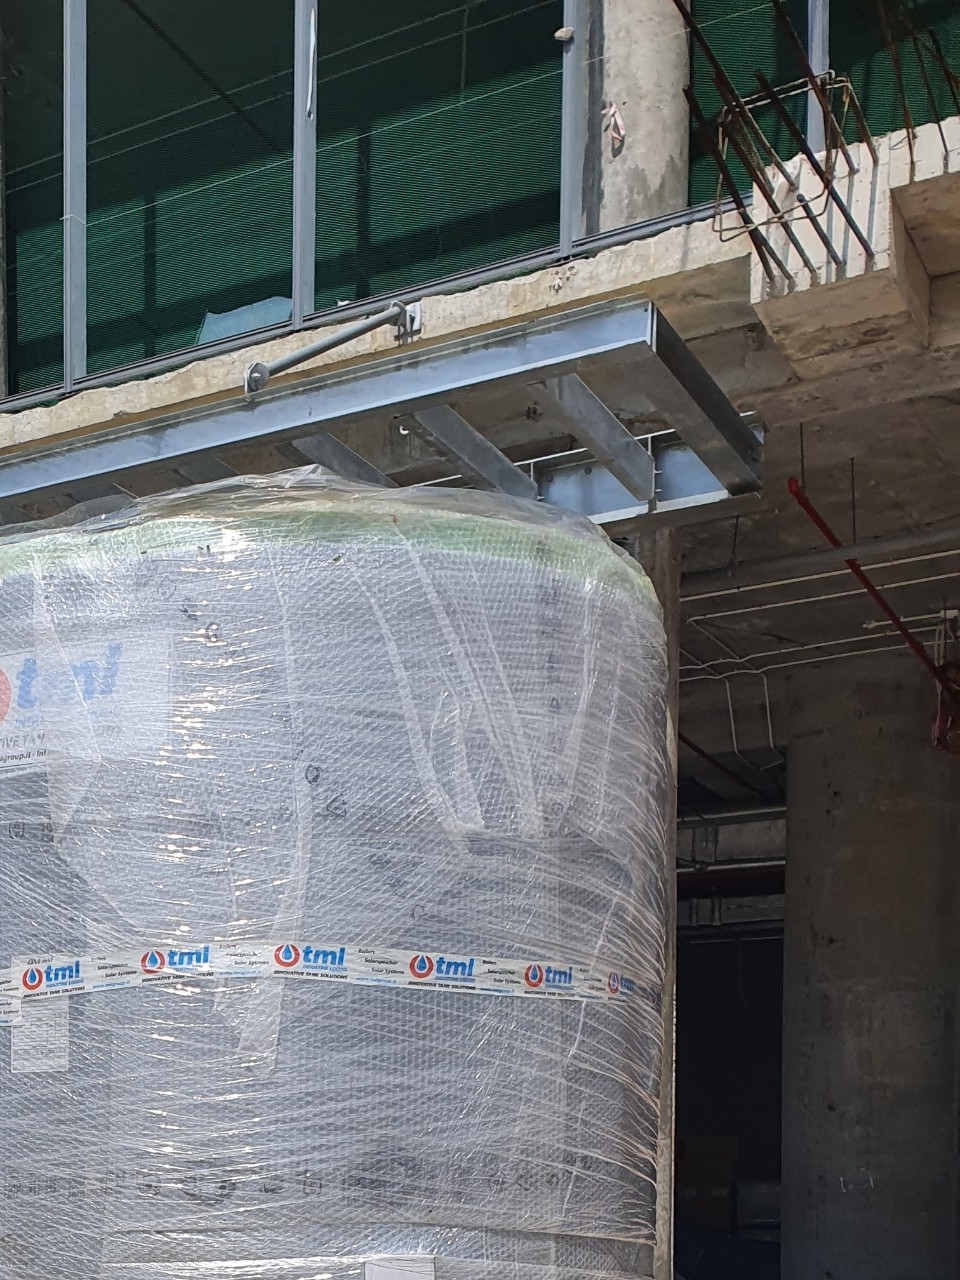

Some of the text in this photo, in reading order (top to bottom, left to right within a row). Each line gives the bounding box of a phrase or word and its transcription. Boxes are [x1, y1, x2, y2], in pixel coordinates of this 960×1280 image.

[167, 945, 209, 966] tml
[302, 946, 345, 965] tml
[44, 960, 80, 981] tml
[436, 957, 475, 977] tml
[545, 966, 573, 984] tml
